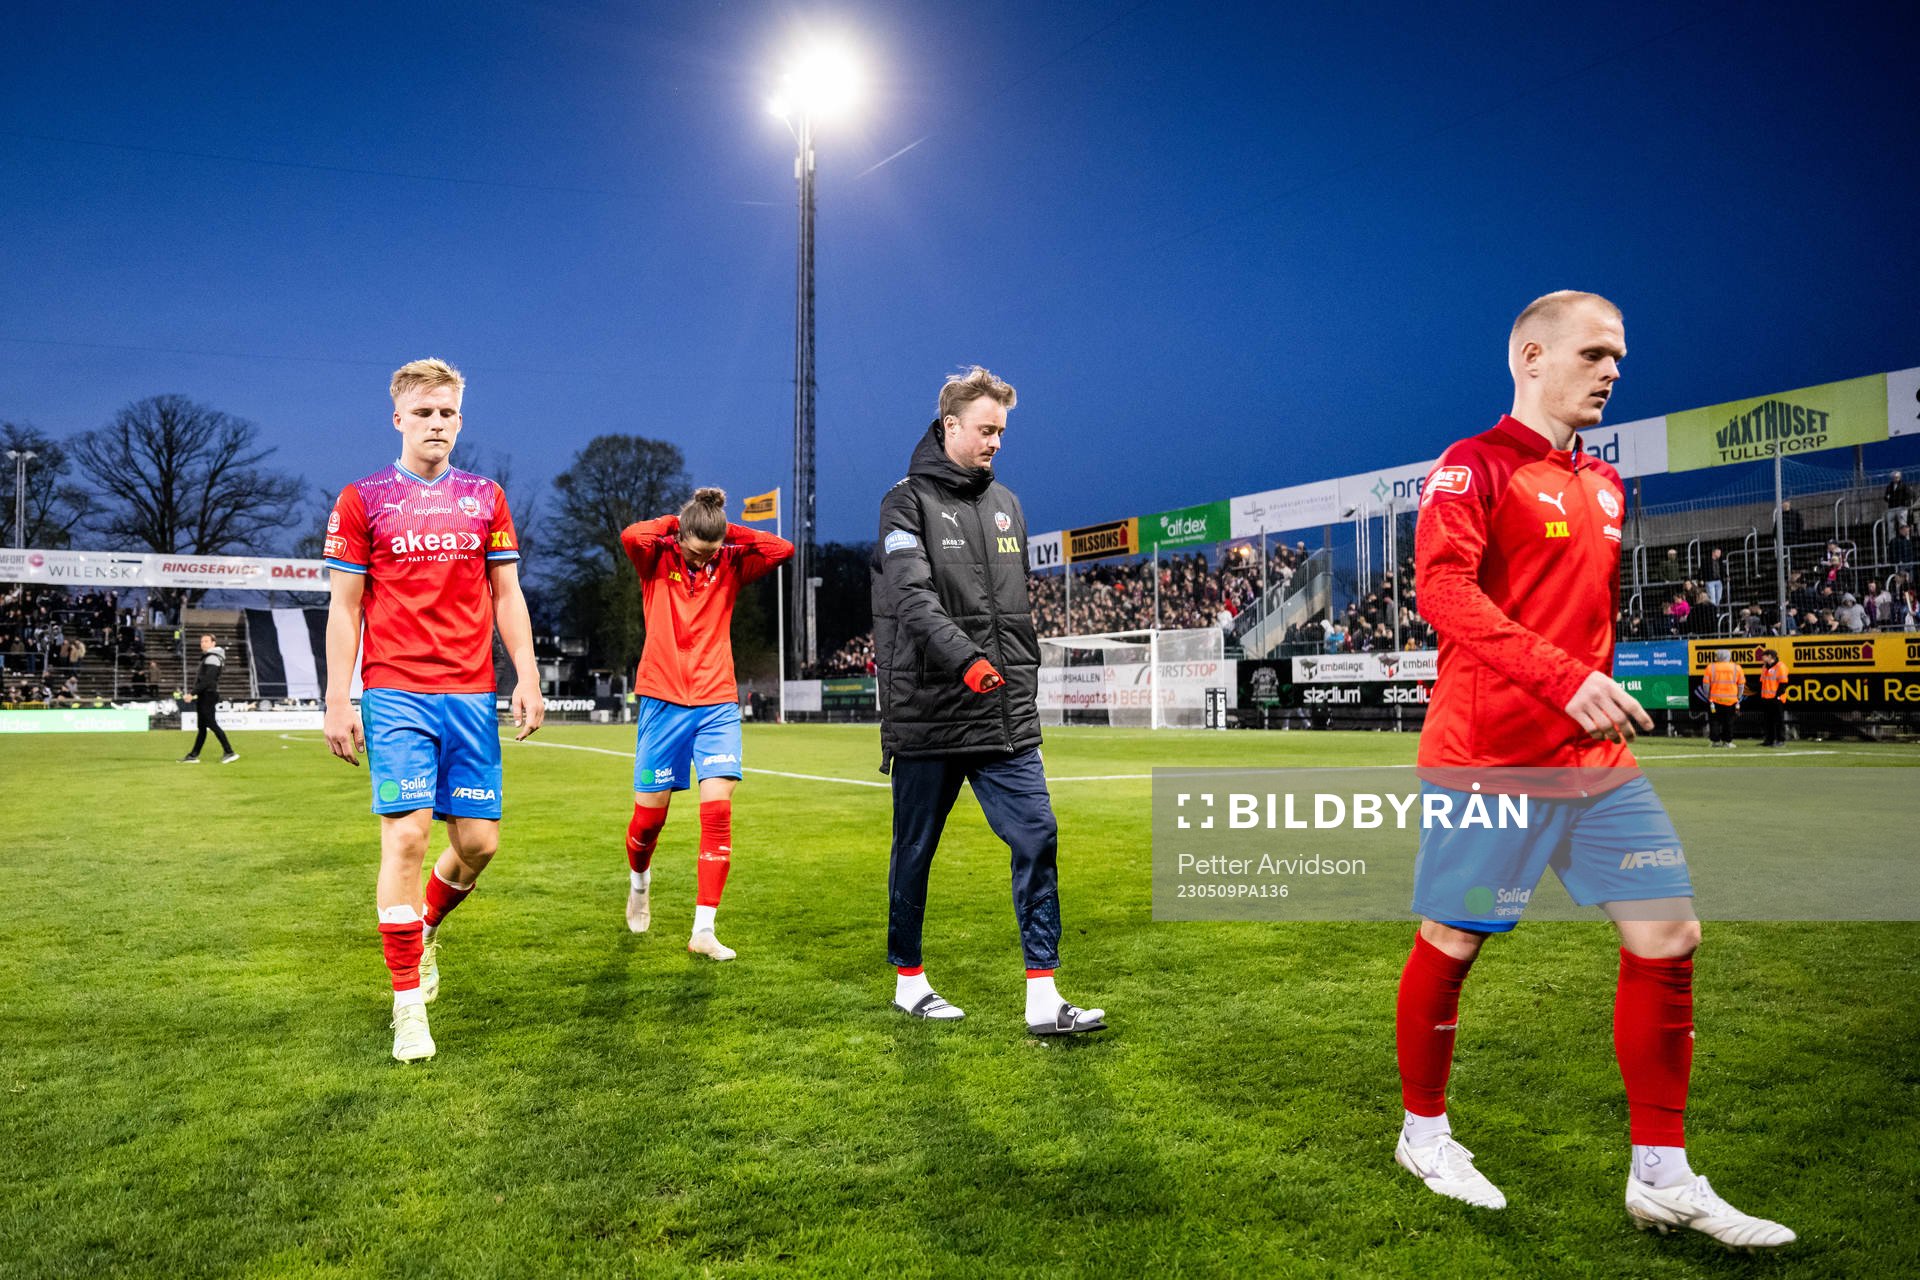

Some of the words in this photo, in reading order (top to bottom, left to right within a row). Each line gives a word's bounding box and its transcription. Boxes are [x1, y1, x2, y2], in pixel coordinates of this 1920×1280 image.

[1716, 400, 1829, 448] VÄXTHUSET
[1719, 435, 1828, 462] TULLSTORP
[1168, 517, 1207, 537] alfdex
[1545, 521, 1570, 538] XXL
[391, 530, 458, 554] akea
[997, 537, 1020, 553] XXL
[1071, 531, 1119, 554] OHLSSONS
[162, 563, 260, 575] RINGSERVICE
[1697, 650, 1753, 662] OHLONS
[1795, 645, 1860, 661] OHLSSONS
[1303, 686, 1361, 704] stadium
[1785, 679, 1869, 702] aRoNi
[401, 777, 427, 791] Solid
[1496, 887, 1532, 904] Solid
